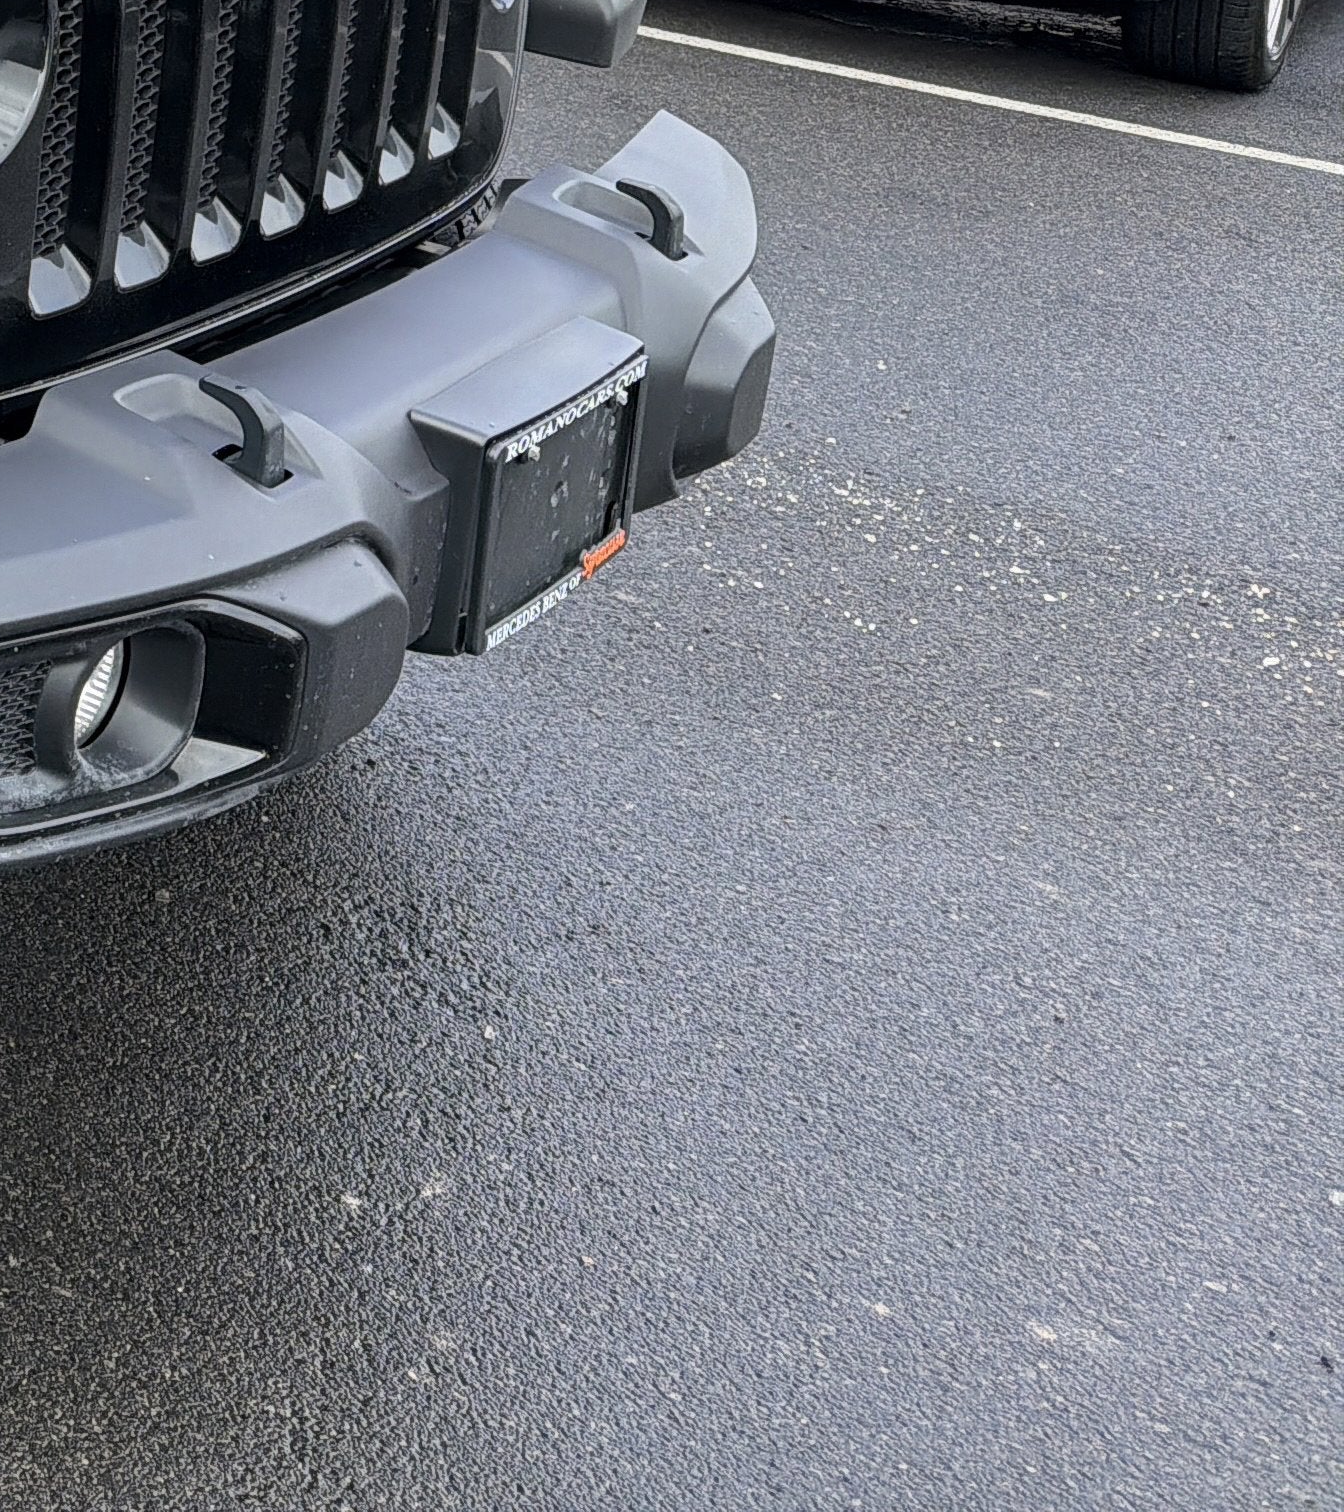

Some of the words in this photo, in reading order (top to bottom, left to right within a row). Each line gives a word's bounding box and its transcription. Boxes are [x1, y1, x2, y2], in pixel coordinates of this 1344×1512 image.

[485, 600, 542, 652] MERCEDES
[541, 581, 569, 614] BENZ
[568, 572, 582, 591] OF
